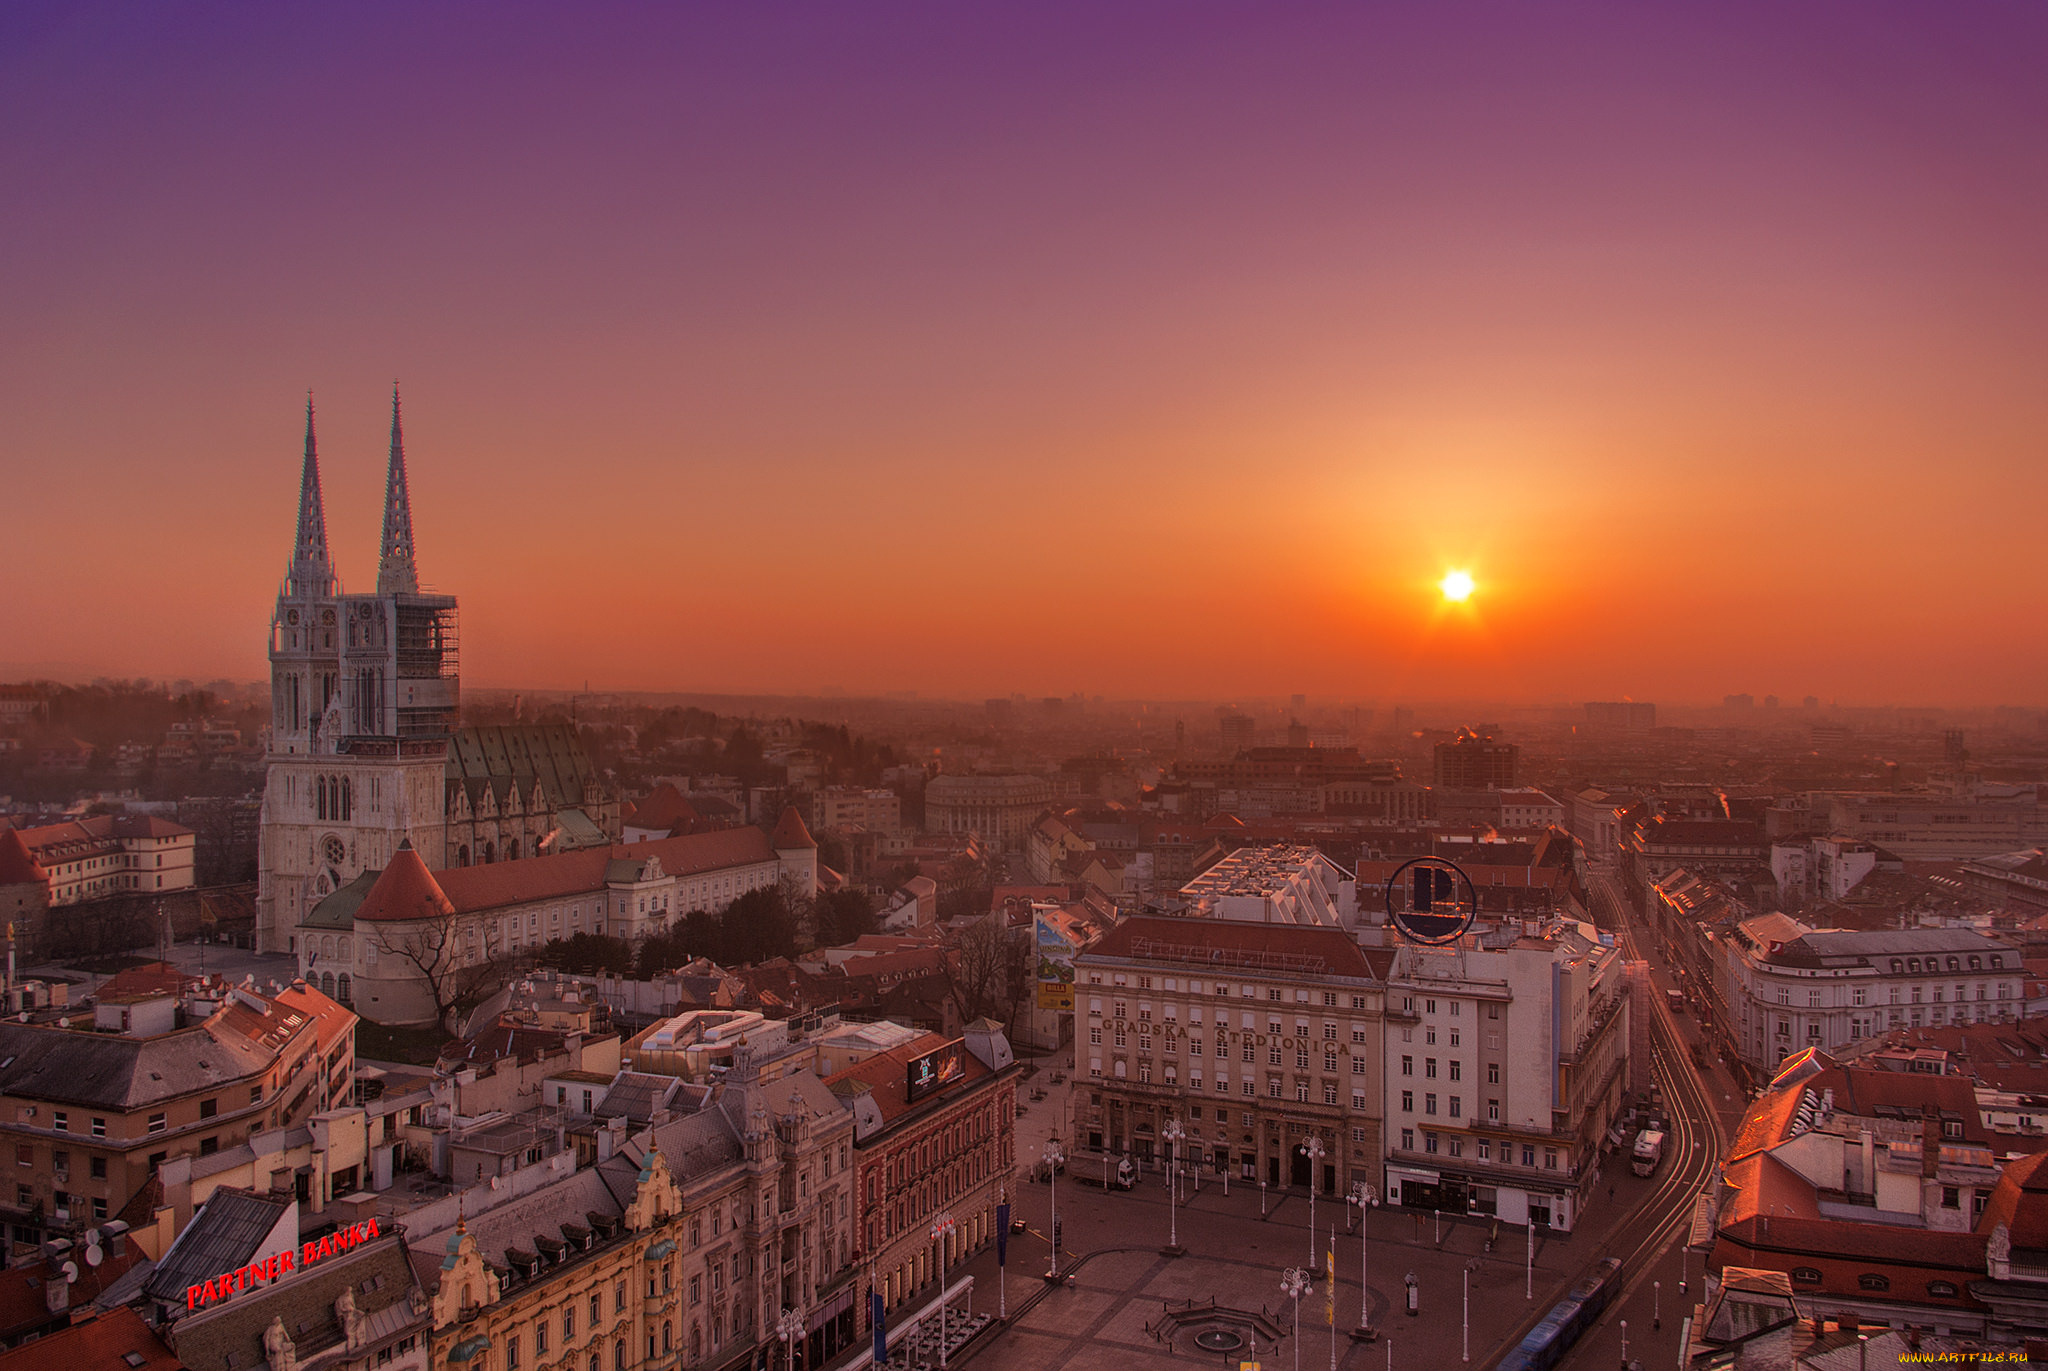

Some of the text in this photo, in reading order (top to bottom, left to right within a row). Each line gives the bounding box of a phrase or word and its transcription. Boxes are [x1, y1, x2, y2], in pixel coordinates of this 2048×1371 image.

[1102, 1019, 1188, 1039] GRADSKA
[187, 1218, 380, 1310] PARTNER BANKA
